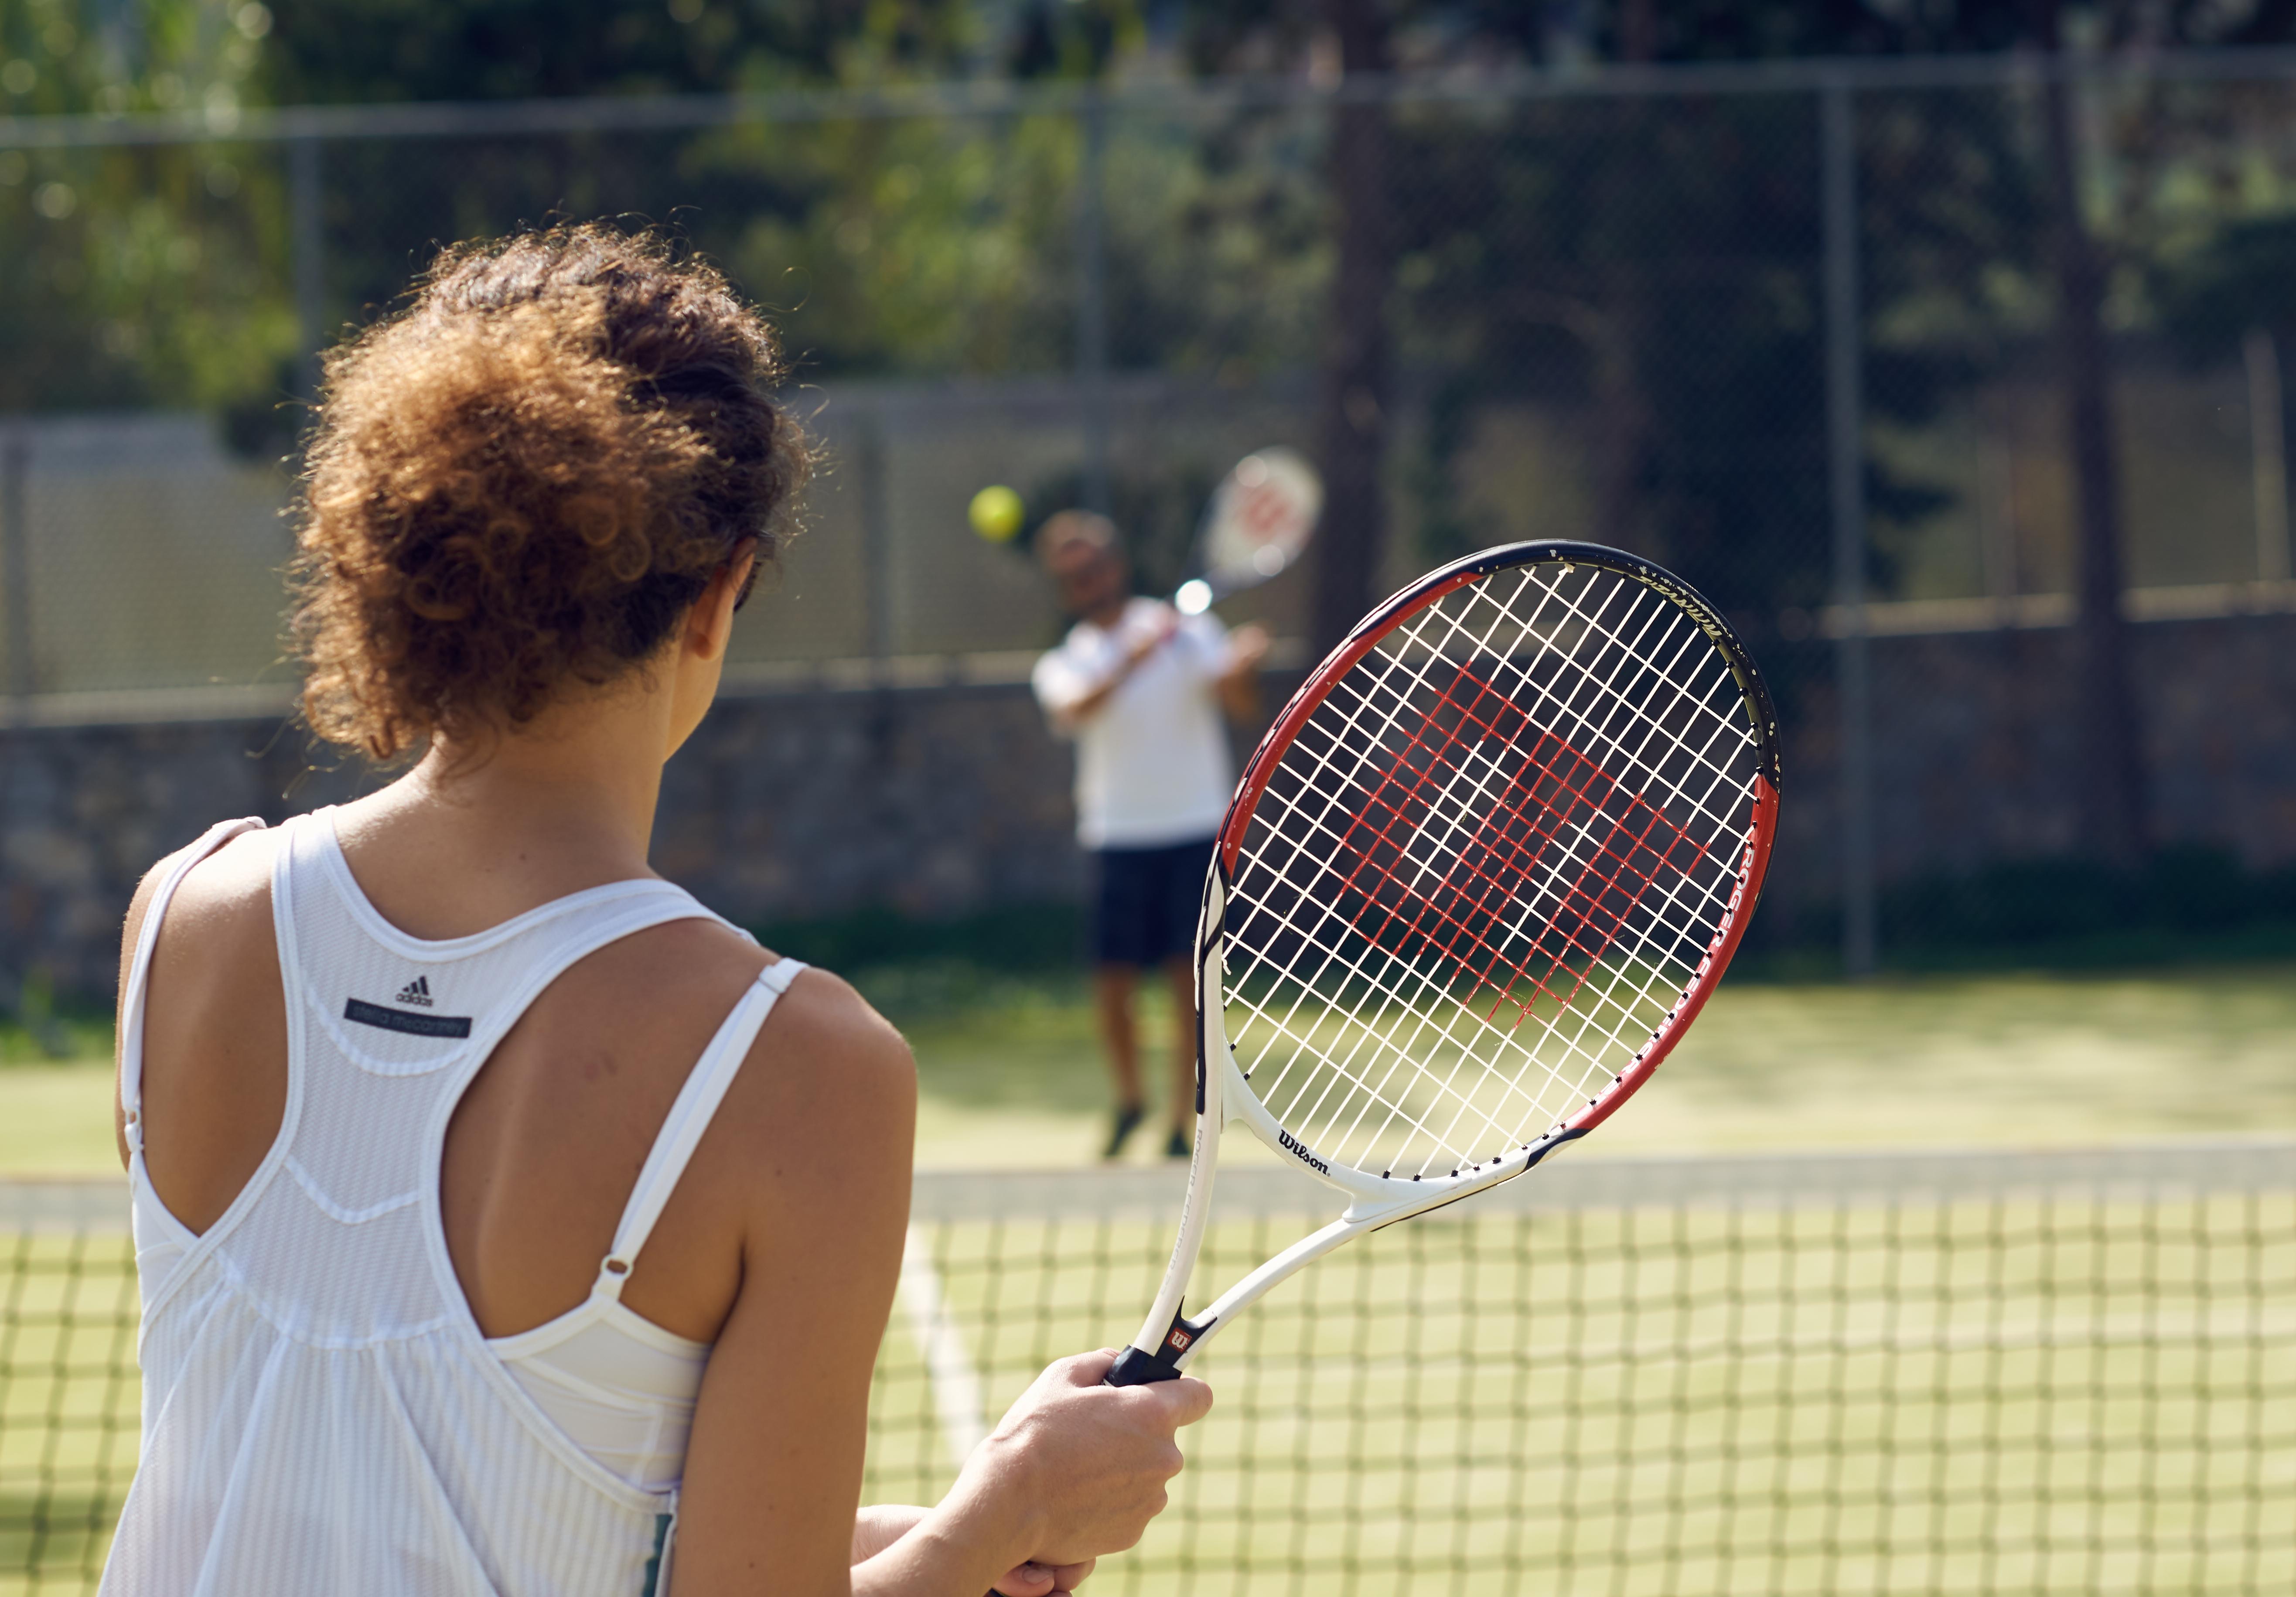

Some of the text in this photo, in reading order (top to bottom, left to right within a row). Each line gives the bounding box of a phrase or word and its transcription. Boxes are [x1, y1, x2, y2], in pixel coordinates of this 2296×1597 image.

[1640, 576, 1723, 636] TITANIUM
[1711, 848, 1755, 947] ROGER
[396, 993, 433, 1007] adidas
[1622, 957, 1710, 1074] FEDERER
[1190, 1129, 1202, 1187] ROGER
[1279, 1129, 1329, 1176] Wilson
[1171, 1193, 1191, 1270] FEDERER
